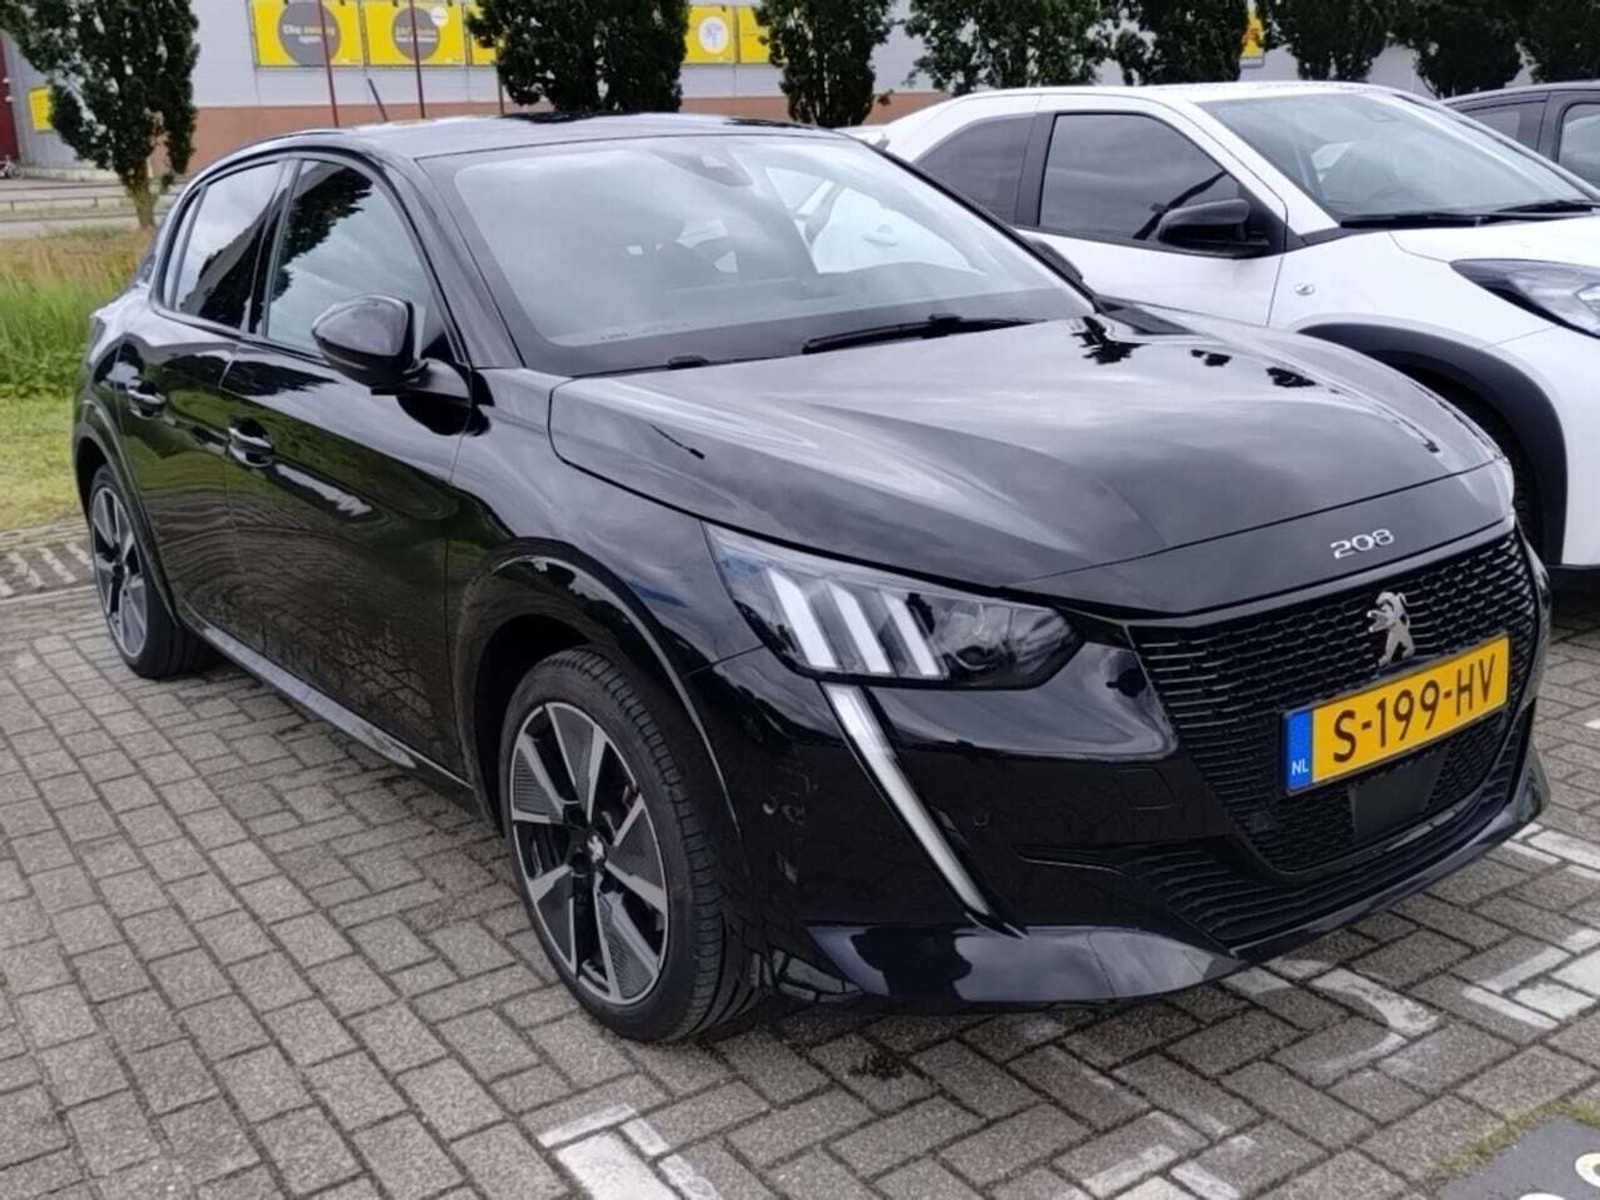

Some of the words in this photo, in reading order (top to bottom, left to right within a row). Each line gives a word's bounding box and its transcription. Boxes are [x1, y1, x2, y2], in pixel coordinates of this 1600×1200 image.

[1330, 528, 1395, 560] 208
[1332, 653, 1496, 764] S-199-HV
[1291, 759, 1309, 776] NL
